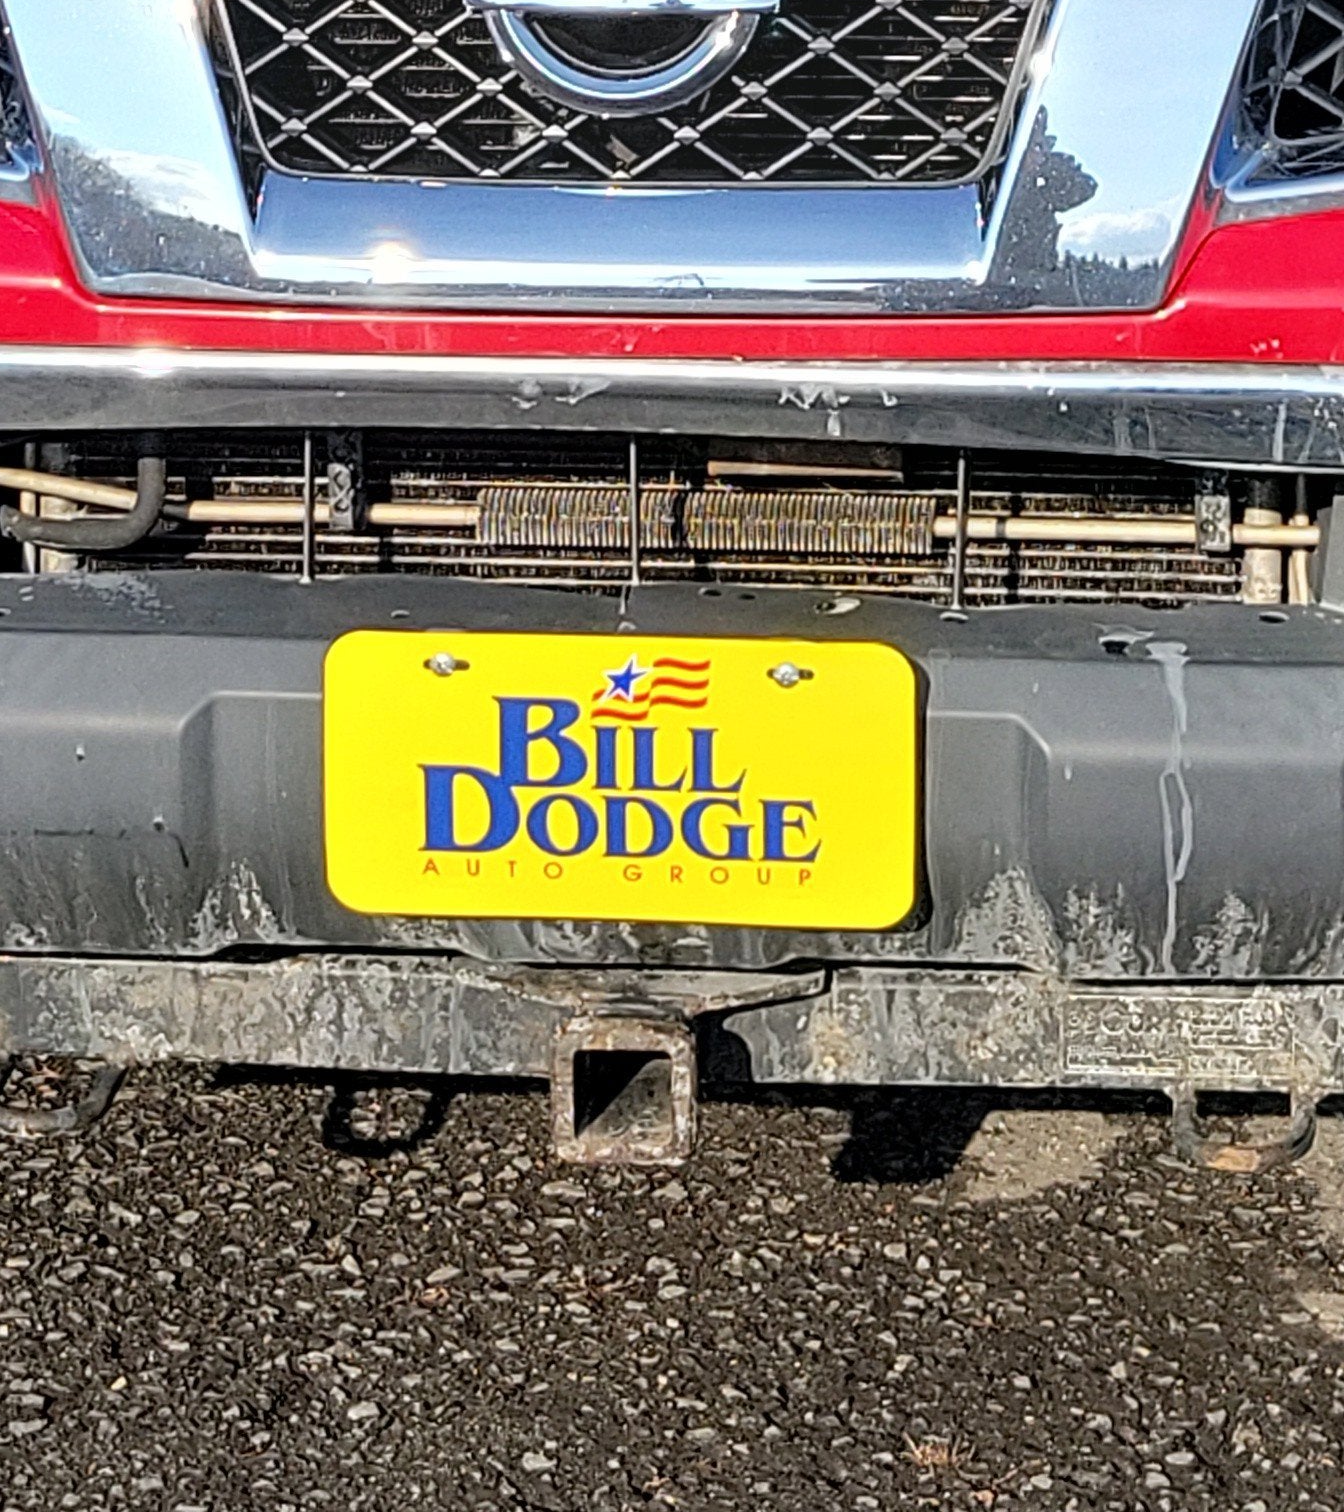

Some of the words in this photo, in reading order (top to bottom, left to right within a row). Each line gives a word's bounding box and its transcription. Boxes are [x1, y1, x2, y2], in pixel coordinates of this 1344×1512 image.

[491, 695, 747, 793] BILL
[417, 763, 823, 864] DODGE
[421, 857, 564, 879] AUTO
[621, 863, 813, 886] GROUP
